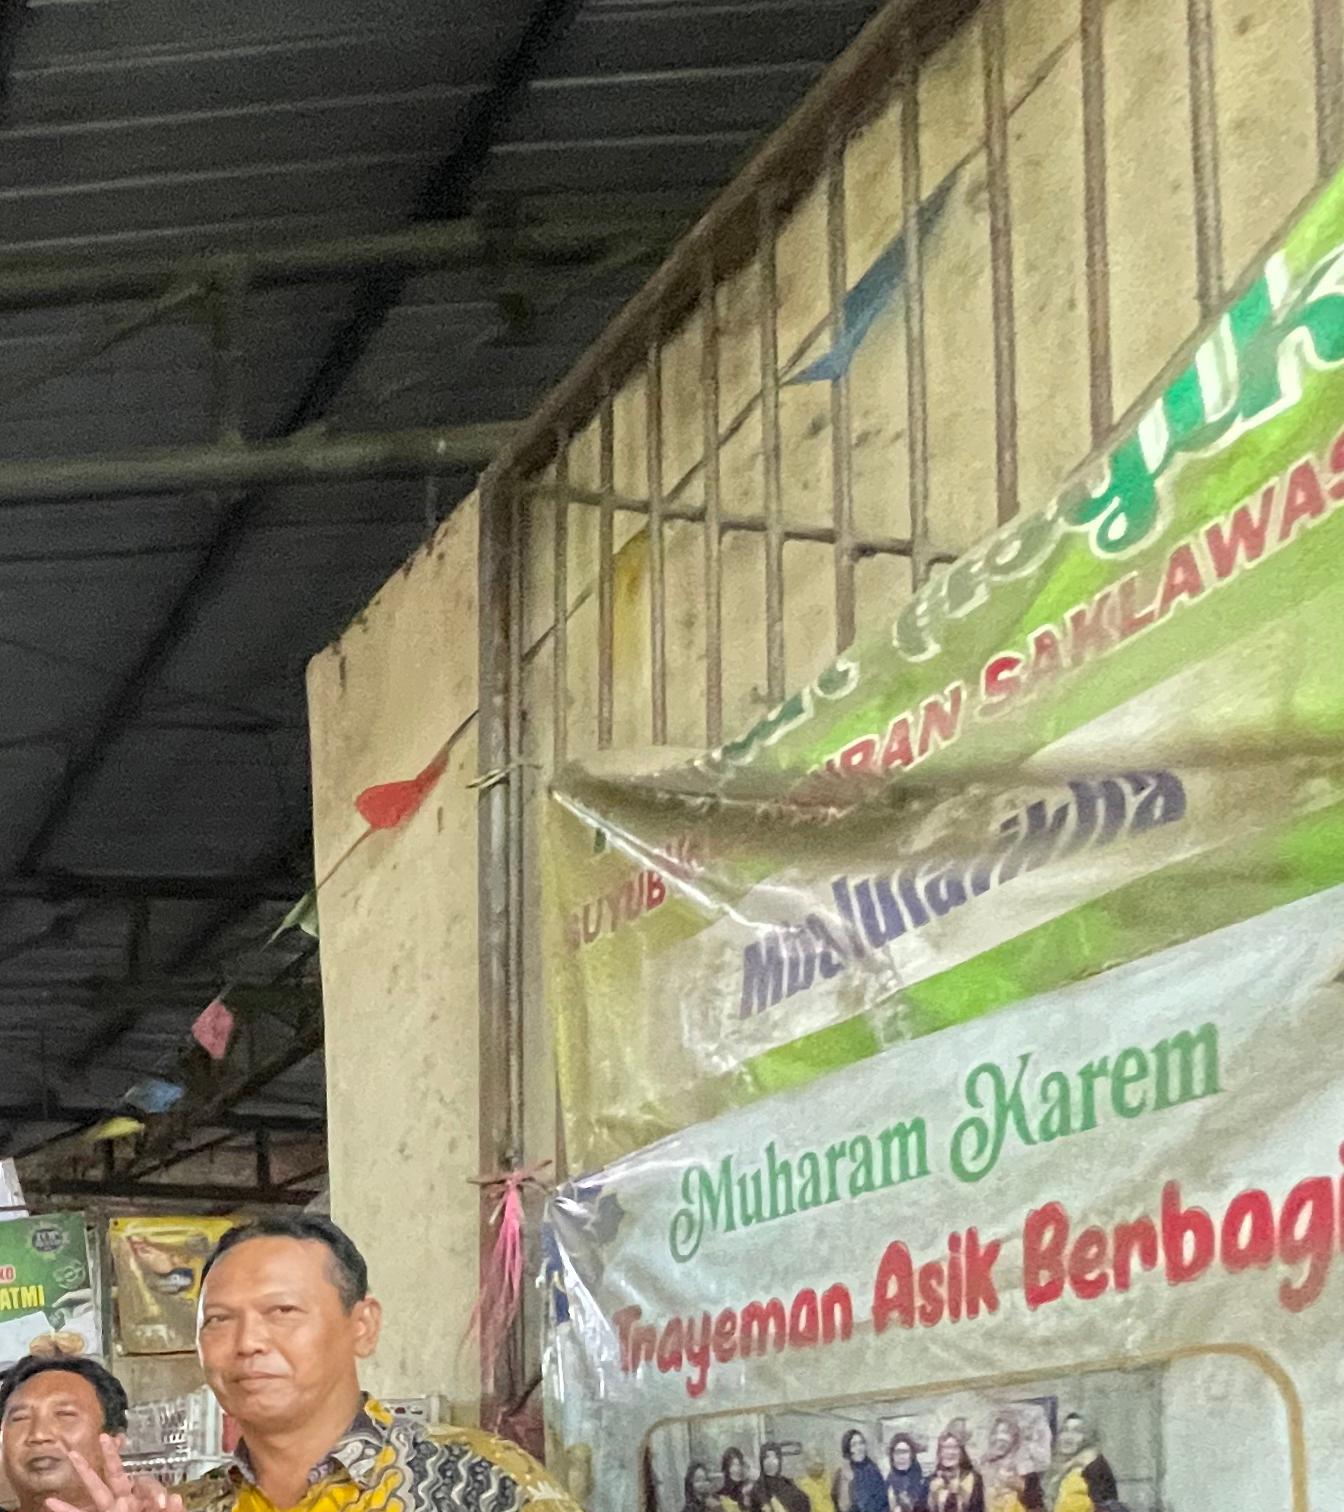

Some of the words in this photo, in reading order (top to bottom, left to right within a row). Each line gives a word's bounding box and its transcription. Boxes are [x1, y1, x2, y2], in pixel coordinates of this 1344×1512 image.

[670, 1117, 929, 1263] Muharam
[950, 1021, 1222, 1183] Karem
[613, 1280, 854, 1397] Trayeman
[872, 1226, 1001, 1336] Asik
[1024, 1138, 1344, 1314] Berbag
